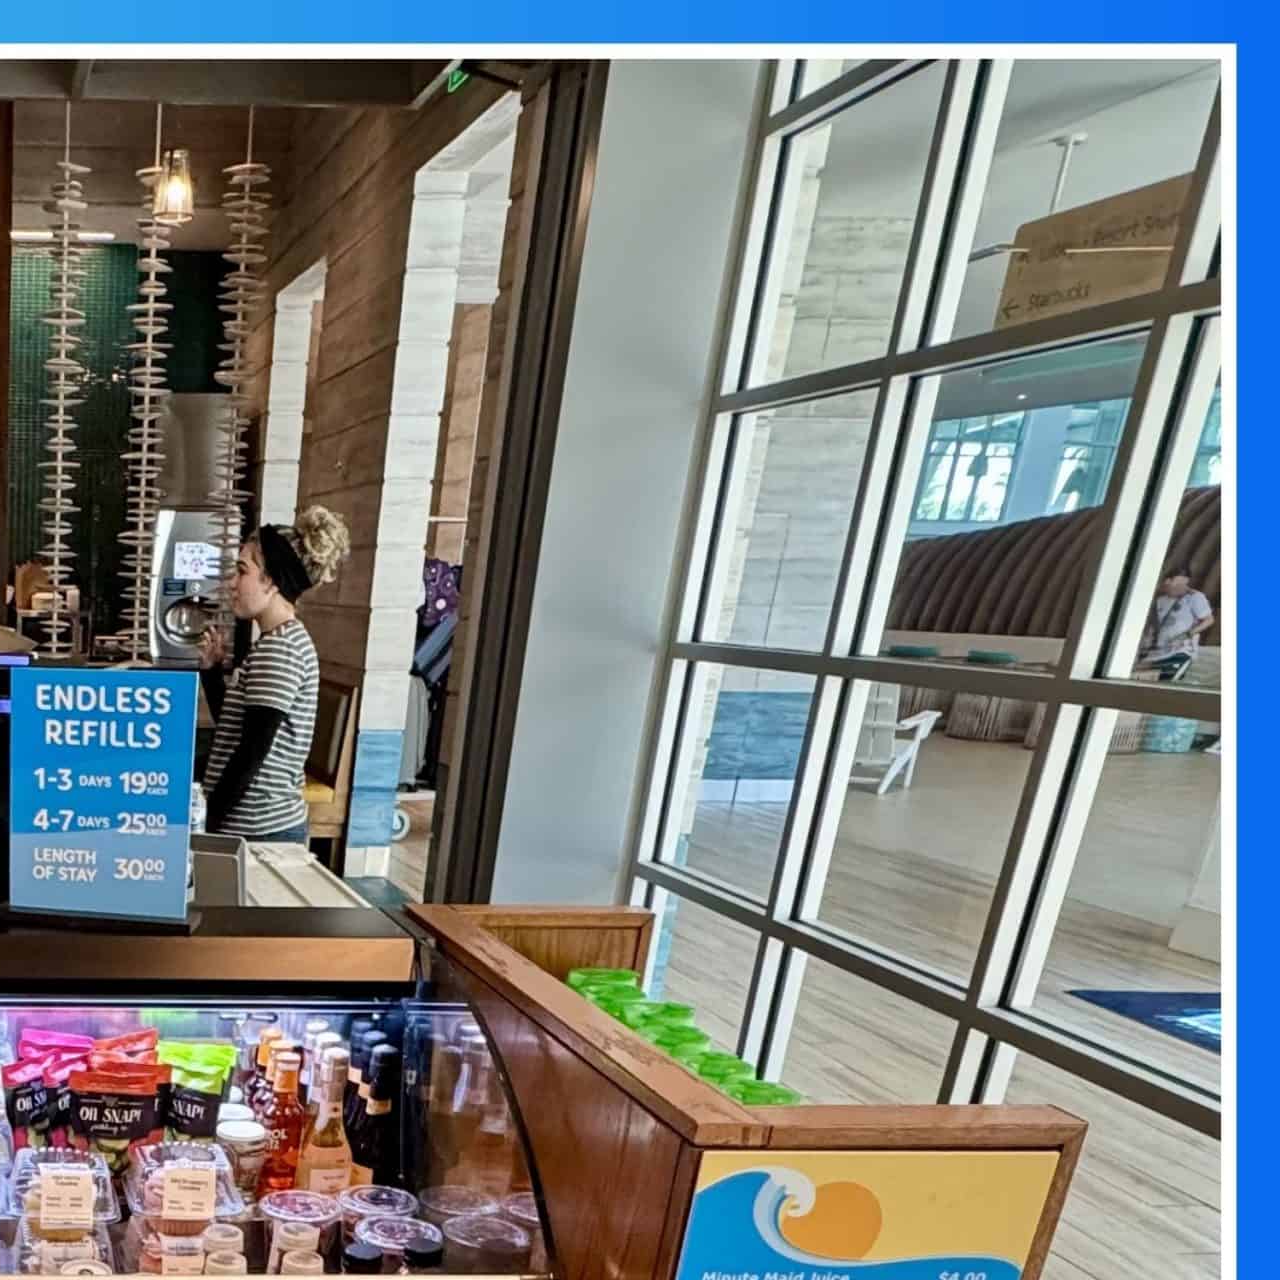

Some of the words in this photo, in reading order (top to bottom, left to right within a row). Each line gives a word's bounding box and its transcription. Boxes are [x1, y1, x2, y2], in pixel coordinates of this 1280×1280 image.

[35, 684, 171, 714] ENDLESS
[45, 720, 161, 749] REFILLS
[33, 768, 72, 790] 1-3
[80, 775, 112, 788] DAYS
[33, 808, 74, 831] 4-7
[77, 816, 110, 828] DAYS
[34, 848, 97, 864] LENGTH
[32, 865, 54, 880] OF
[58, 866, 98, 882] STAY
